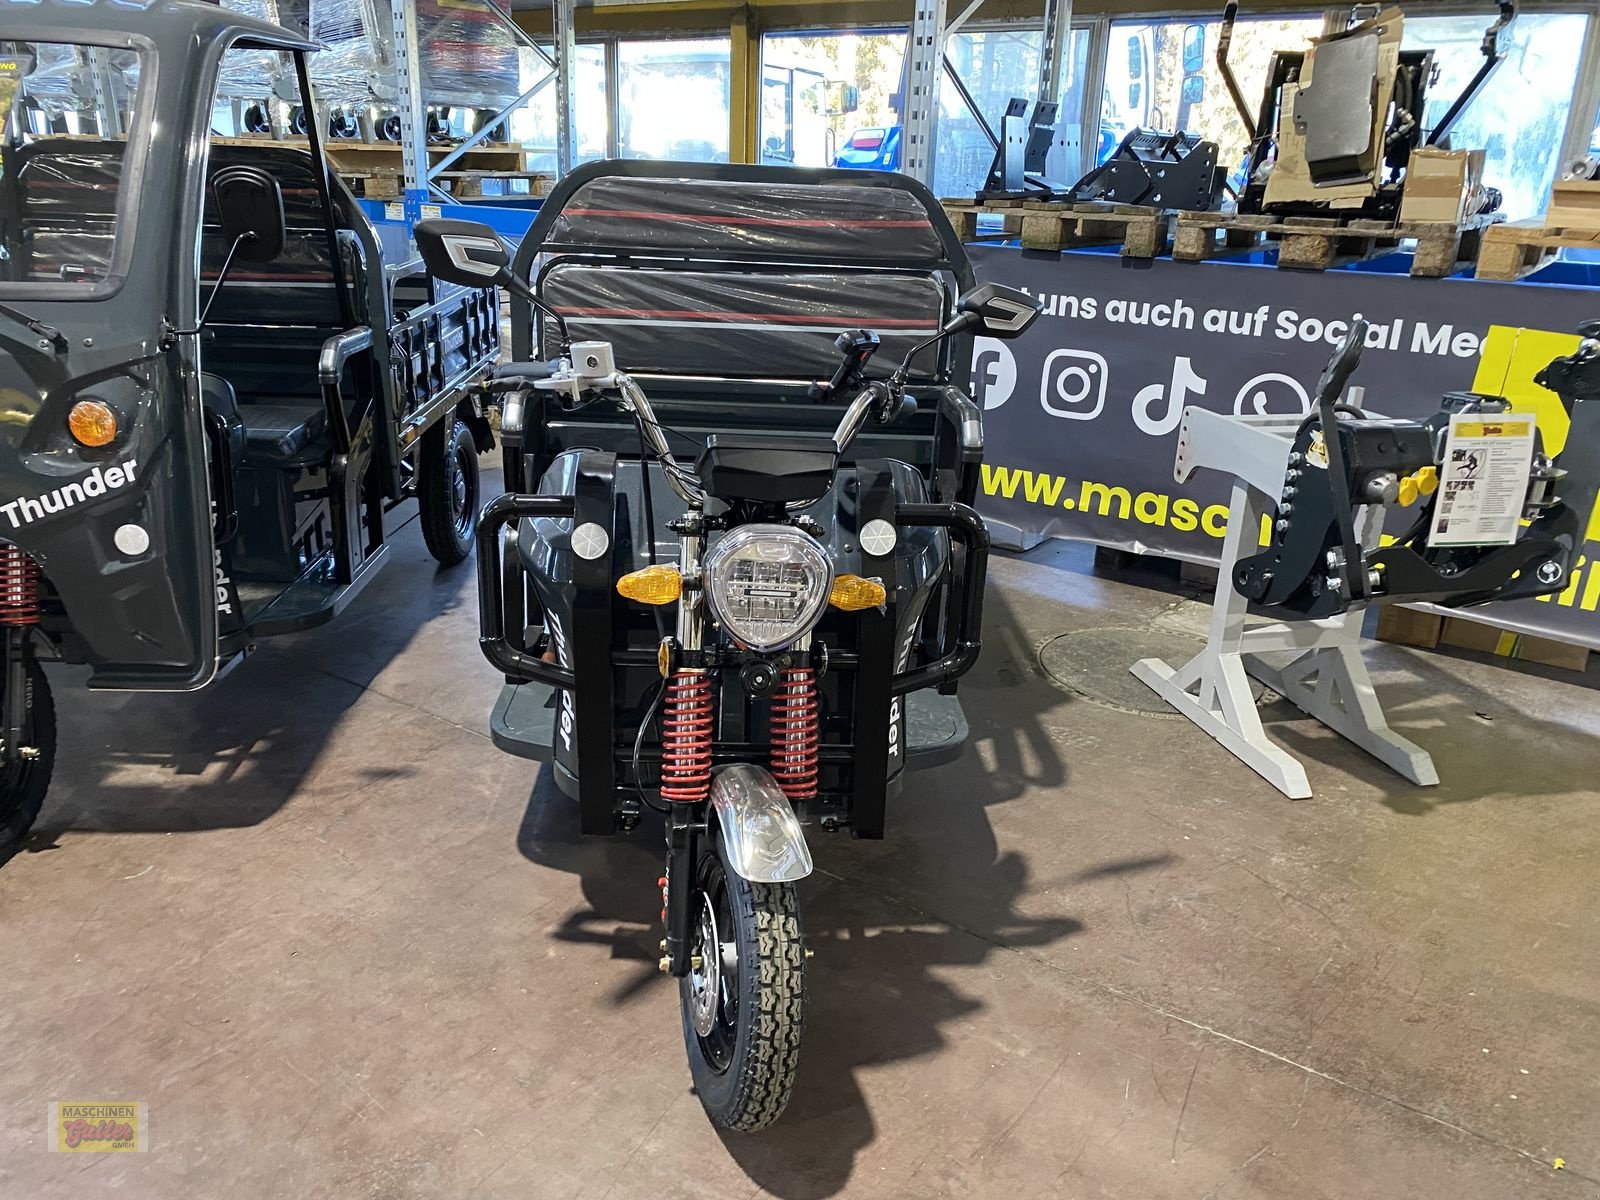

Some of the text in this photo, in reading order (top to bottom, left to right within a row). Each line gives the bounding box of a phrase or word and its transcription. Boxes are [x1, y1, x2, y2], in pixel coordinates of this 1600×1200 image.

[1038, 292, 1098, 319] uns
[1104, 299, 1195, 331] auch
[1202, 305, 1270, 337] auf
[1410, 321, 1488, 358] Me
[0, 458, 138, 529] Thunder
[547, 607, 575, 752] Thuder
[888, 615, 920, 757] Thuder
